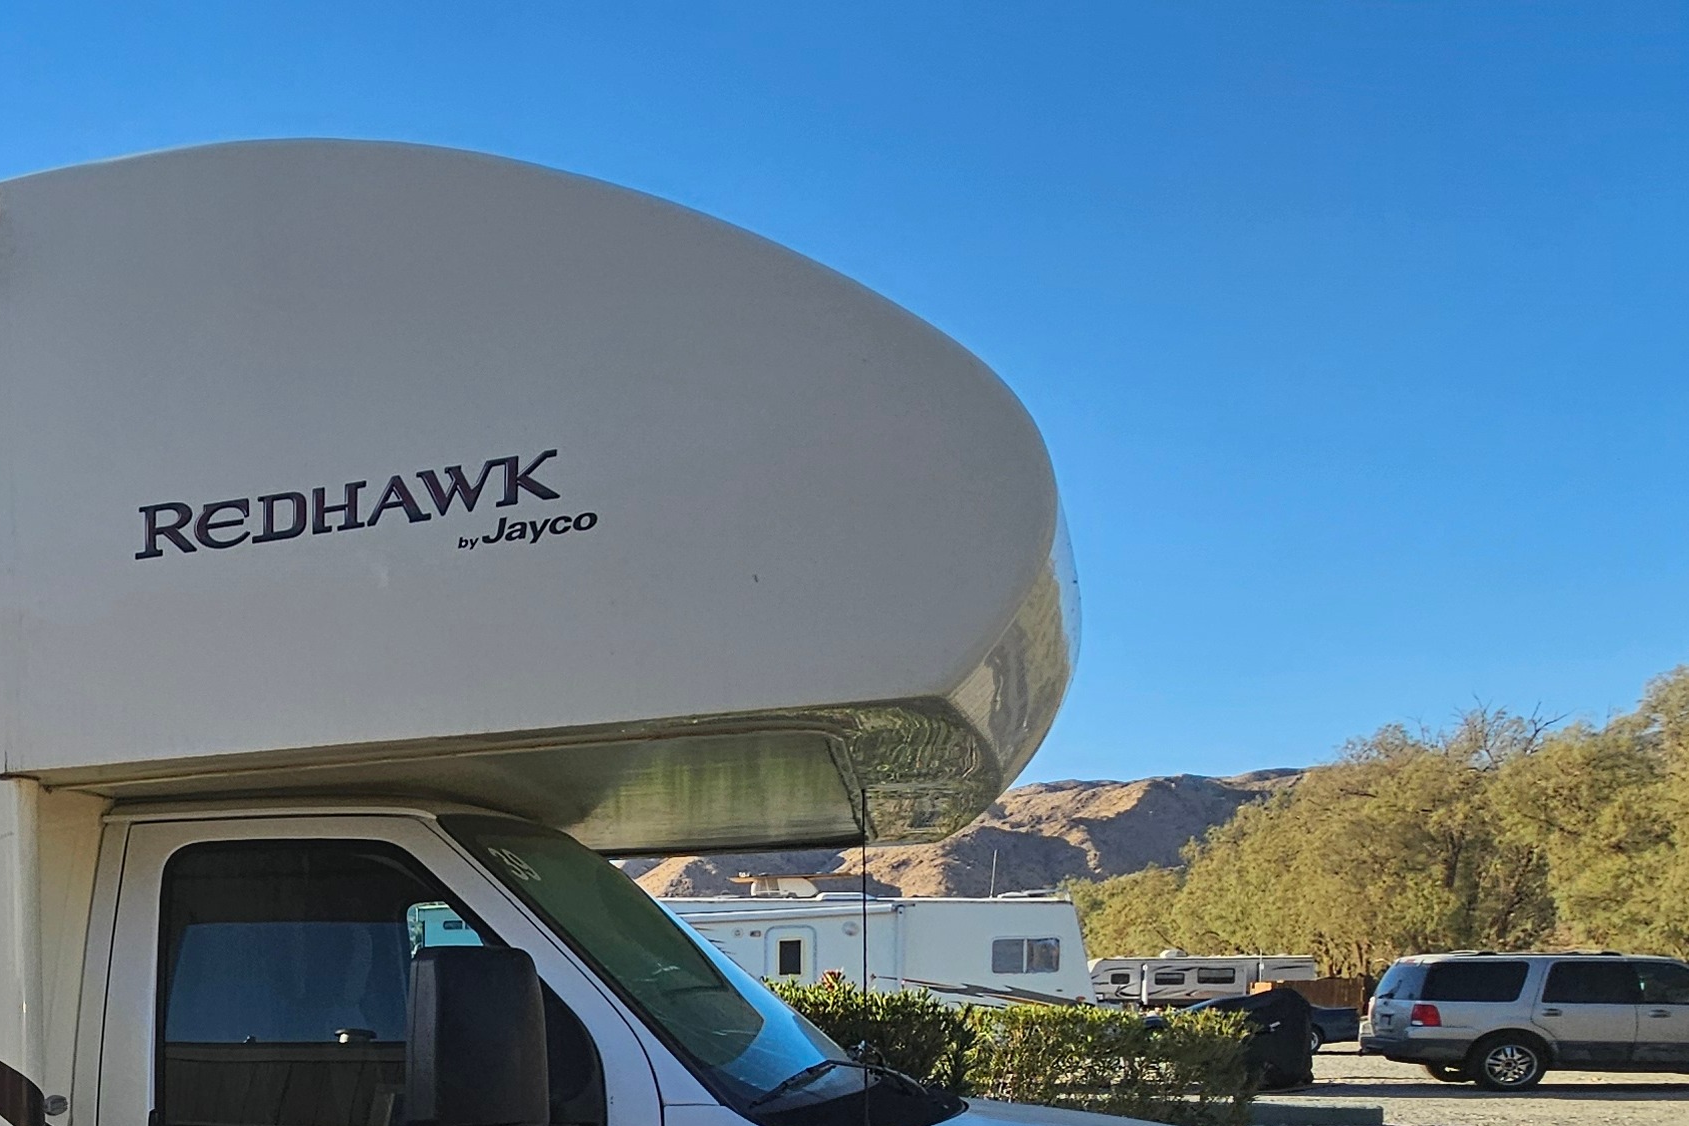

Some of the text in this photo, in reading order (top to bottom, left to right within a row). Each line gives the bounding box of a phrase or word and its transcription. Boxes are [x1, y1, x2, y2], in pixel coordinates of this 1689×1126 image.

[458, 512, 598, 550] by Jayco
[488, 847, 542, 881] 39
